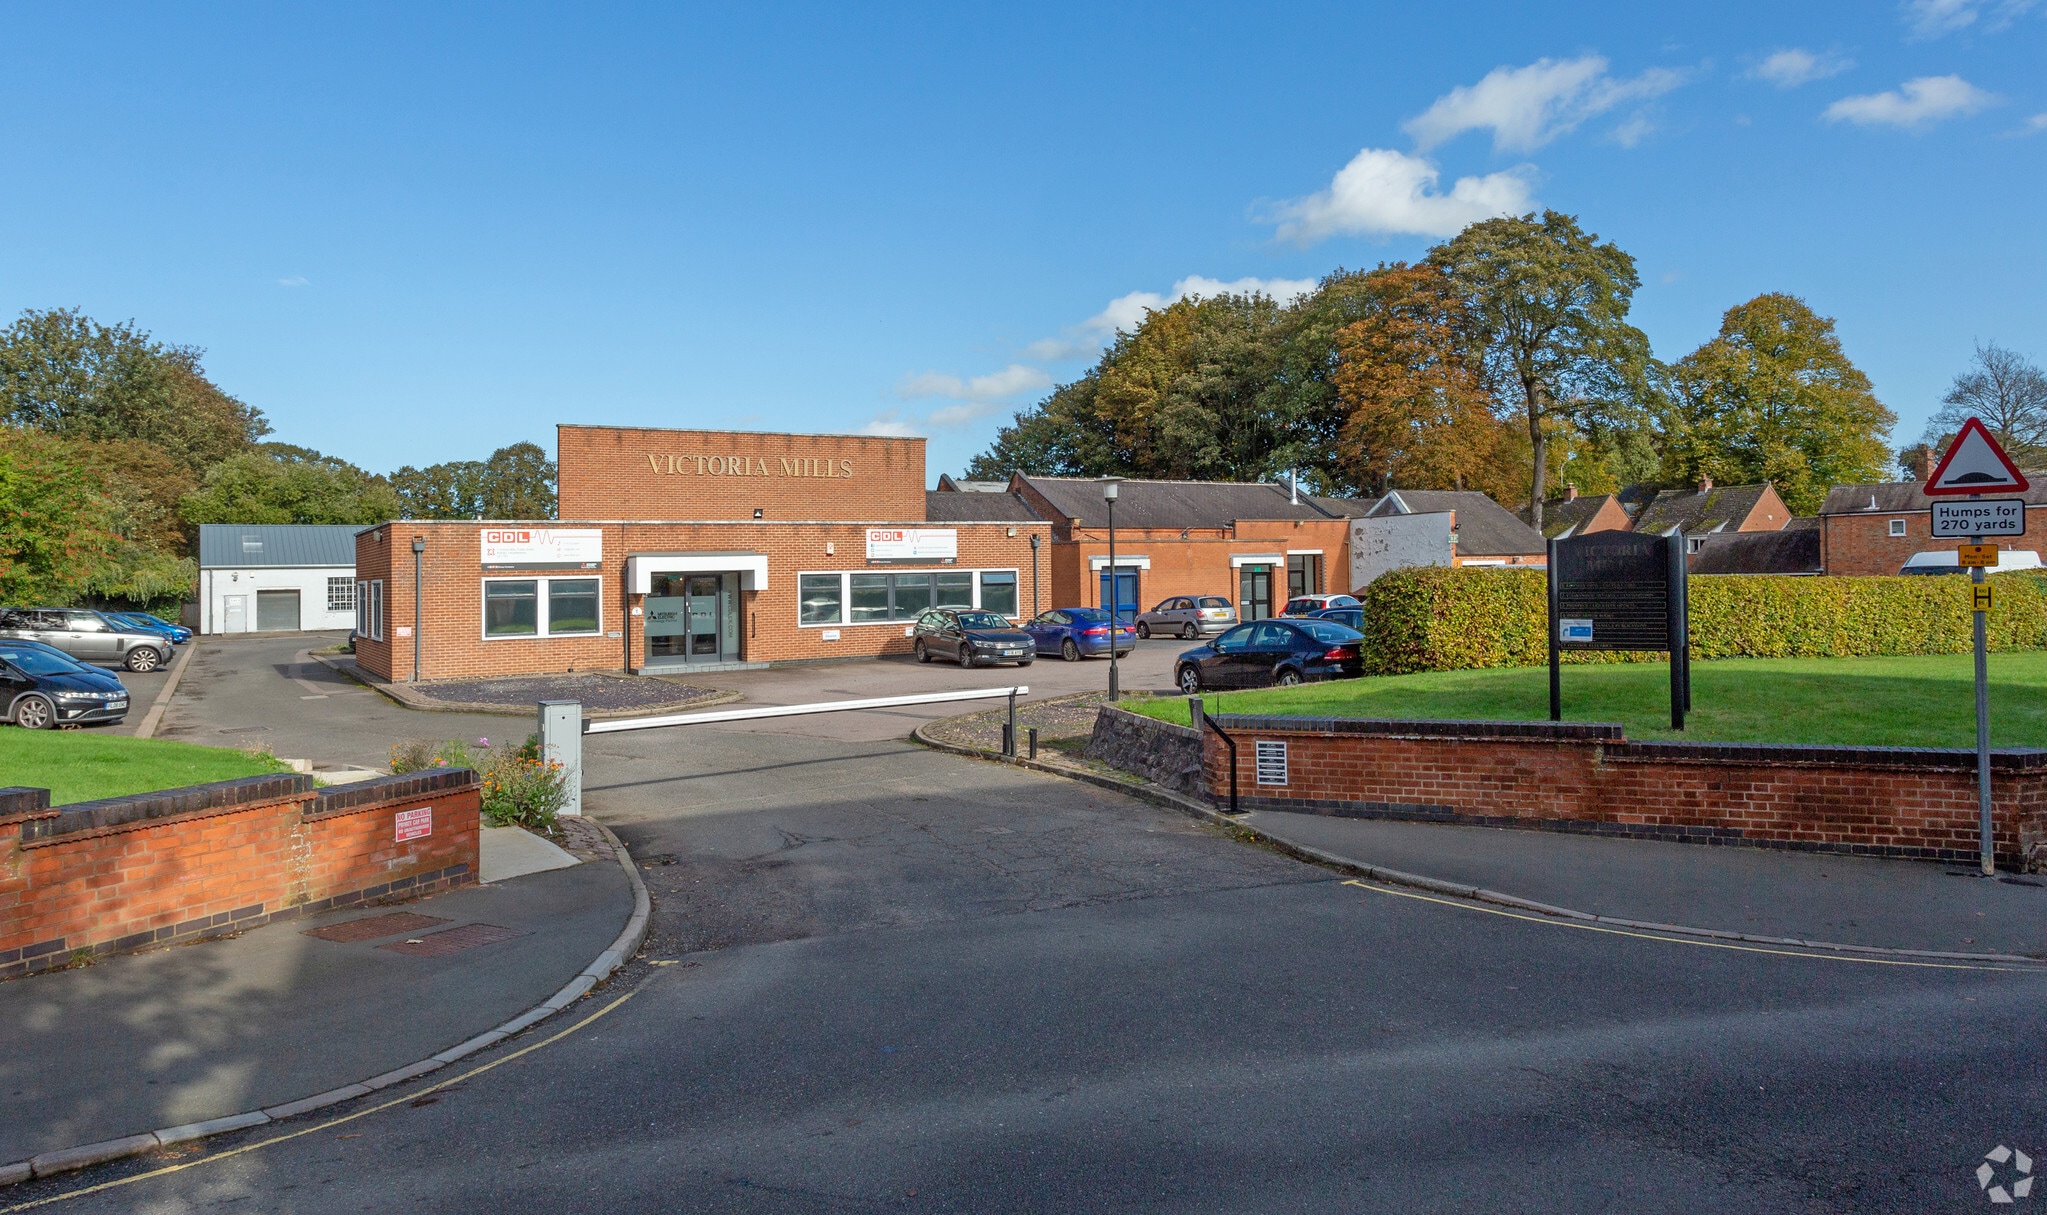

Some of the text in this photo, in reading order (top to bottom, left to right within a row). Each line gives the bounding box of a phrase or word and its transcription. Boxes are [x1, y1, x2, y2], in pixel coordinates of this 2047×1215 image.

[646, 454, 853, 479] VICTORIA MILLS
[1940, 506, 2017, 518] Humps for
[1941, 519, 2016, 531] 270 yards
[487, 531, 530, 543] CDL
[871, 531, 903, 542] CDL
[1974, 587, 1991, 608] H
[407, 808, 430, 819] PARKING
